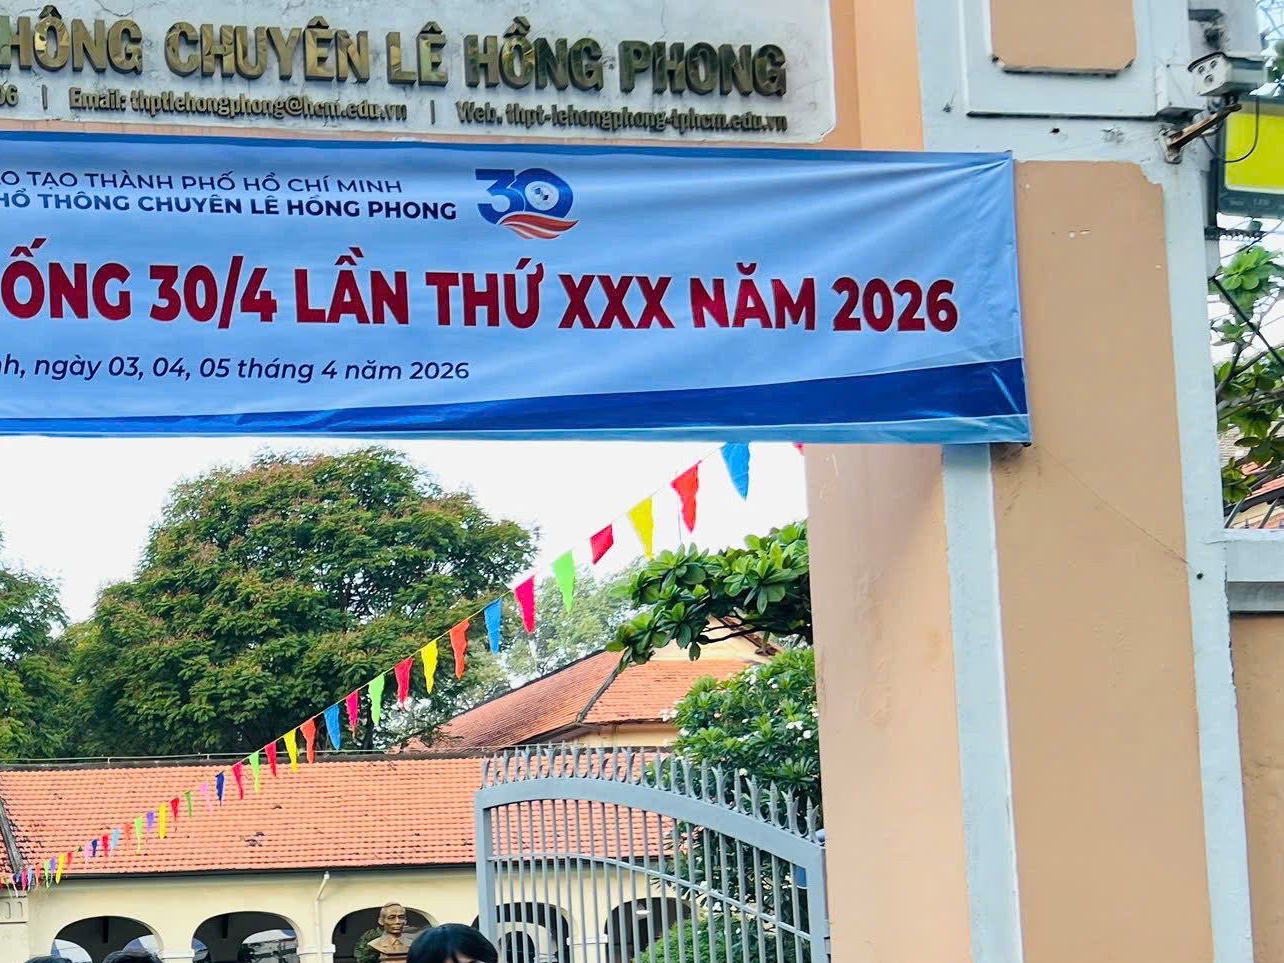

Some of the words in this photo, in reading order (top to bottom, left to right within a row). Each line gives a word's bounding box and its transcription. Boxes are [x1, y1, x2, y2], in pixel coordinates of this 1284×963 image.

[166, 15, 370, 83] CHUYÊN
[386, 21, 448, 87] LÊ
[463, 16, 604, 92] HỒNG
[618, 38, 787, 97] PHONG
[69, 87, 126, 110] Email:
[130, 88, 408, 121] thptlehongphong@hcm.edu.vn
[26, 171, 78, 190] TẠO
[84, 169, 173, 190] THÀNH
[182, 170, 236, 191] PHỐ
[243, 171, 281, 192] HỒ
[287, 174, 330, 193] CHÍ
[337, 178, 403, 194] MINH
[475, 168, 574, 225] 30
[37, 191, 130, 211] THÔNG
[137, 194, 243, 214] CHUYÊN
[250, 195, 280, 215] LÊ
[287, 194, 361, 217] HỒNG
[368, 201, 457, 220] PHONG
[149, 255, 277, 329] 30/4
[294, 246, 409, 325] LẦN
[425, 257, 544, 329] THỨ
[558, 273, 676, 329] XXX
[690, 262, 816, 330] NĂM
[831, 276, 959, 332] 2026
[34, 355, 102, 380] ngày
[108, 356, 144, 380] 03,
[152, 356, 190, 381] 04,
[199, 357, 231, 378] 05
[237, 357, 313, 383] tháng
[321, 359, 338, 380] 4
[345, 358, 403, 380] năm
[409, 361, 470, 380] 2026
